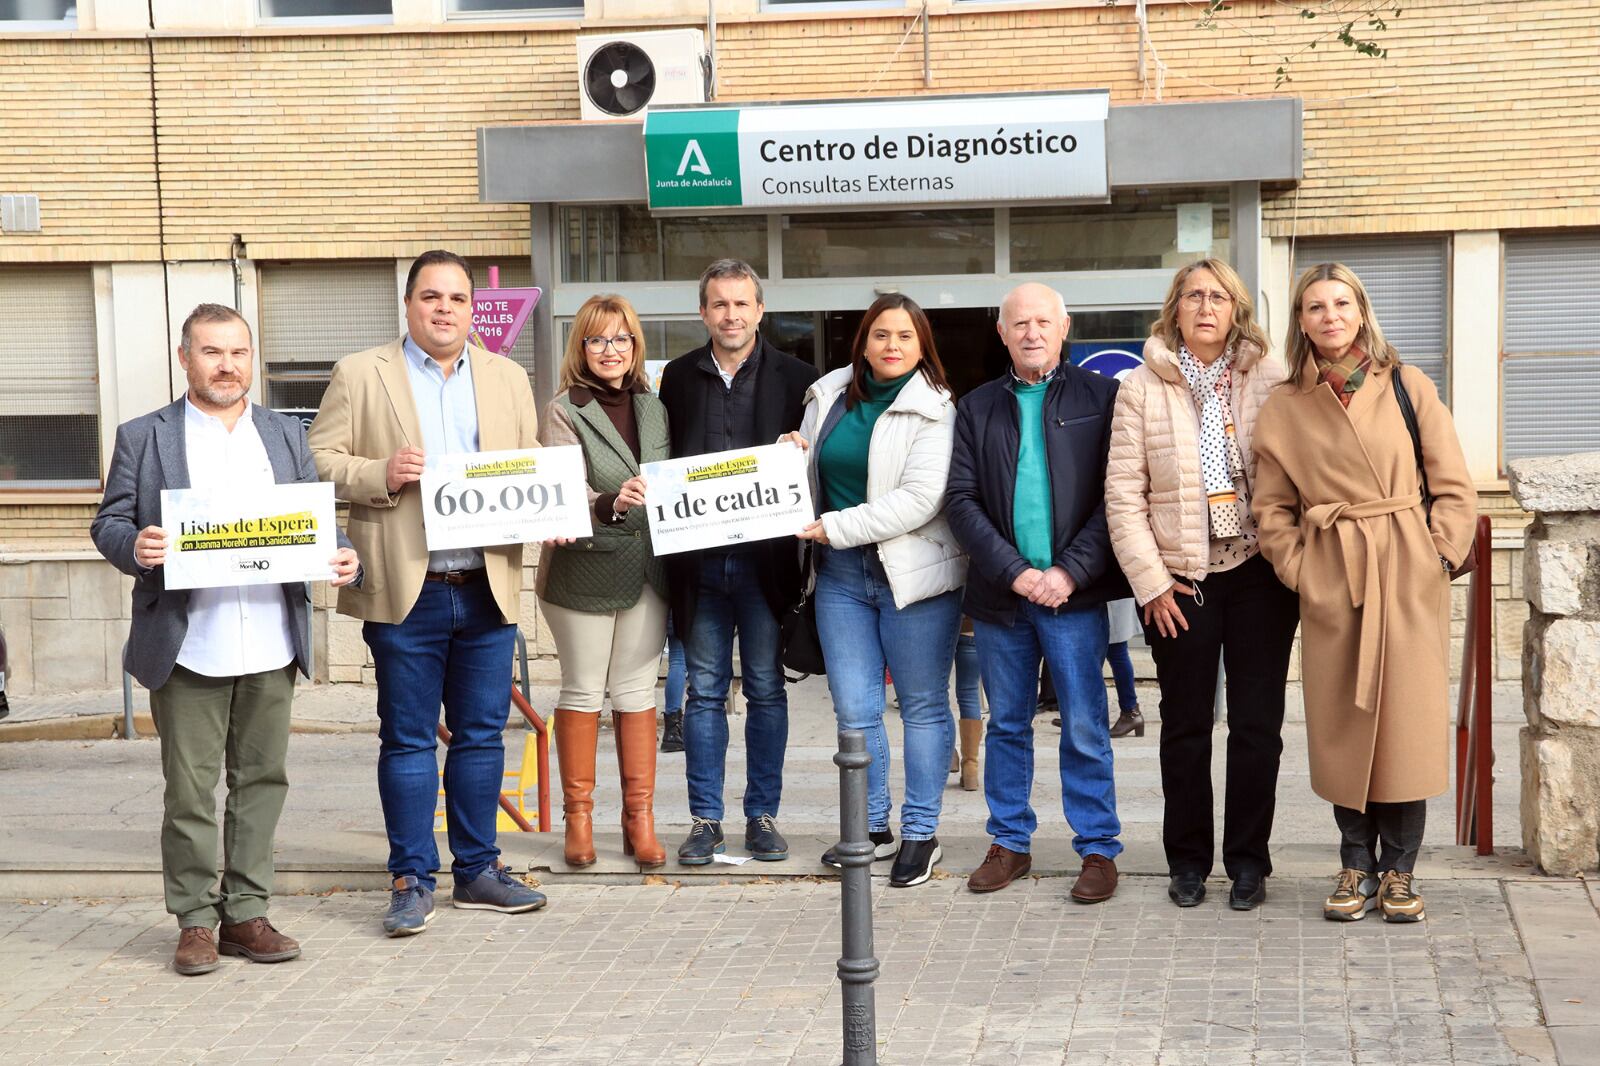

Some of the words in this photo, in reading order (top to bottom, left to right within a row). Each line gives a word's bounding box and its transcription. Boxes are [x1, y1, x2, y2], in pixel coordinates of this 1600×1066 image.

[760, 139, 856, 162] Centro
[864, 135, 898, 159] de
[907, 127, 1077, 163] Diagnóstico
[656, 180, 679, 188] Junta
[680, 179, 691, 187] de
[692, 177, 732, 187] Andalucía
[762, 175, 862, 194] Consultas
[868, 174, 954, 192] Externas
[477, 302, 493, 312] NO
[495, 301, 509, 311] TE
[472, 314, 514, 324] CALLES
[465, 462, 492, 471] Listas
[493, 460, 503, 469] de
[505, 459, 536, 469] Espera
[686, 465, 712, 475] Listas
[714, 461, 725, 470] de
[727, 458, 757, 469] Espera
[434, 481, 567, 517] 60.091
[655, 504, 667, 522] 1
[674, 492, 707, 519] de
[715, 481, 780, 513] cada
[788, 483, 802, 506] 5
[180, 520, 230, 536] Listas
[233, 517, 254, 533] de
[258, 516, 313, 534] Espera
[195, 540, 221, 550] Juanma
[221, 537, 248, 548] MoreNO
[249, 538, 258, 547] en
[258, 536, 265, 546] la
[266, 535, 292, 546] Sanidad
